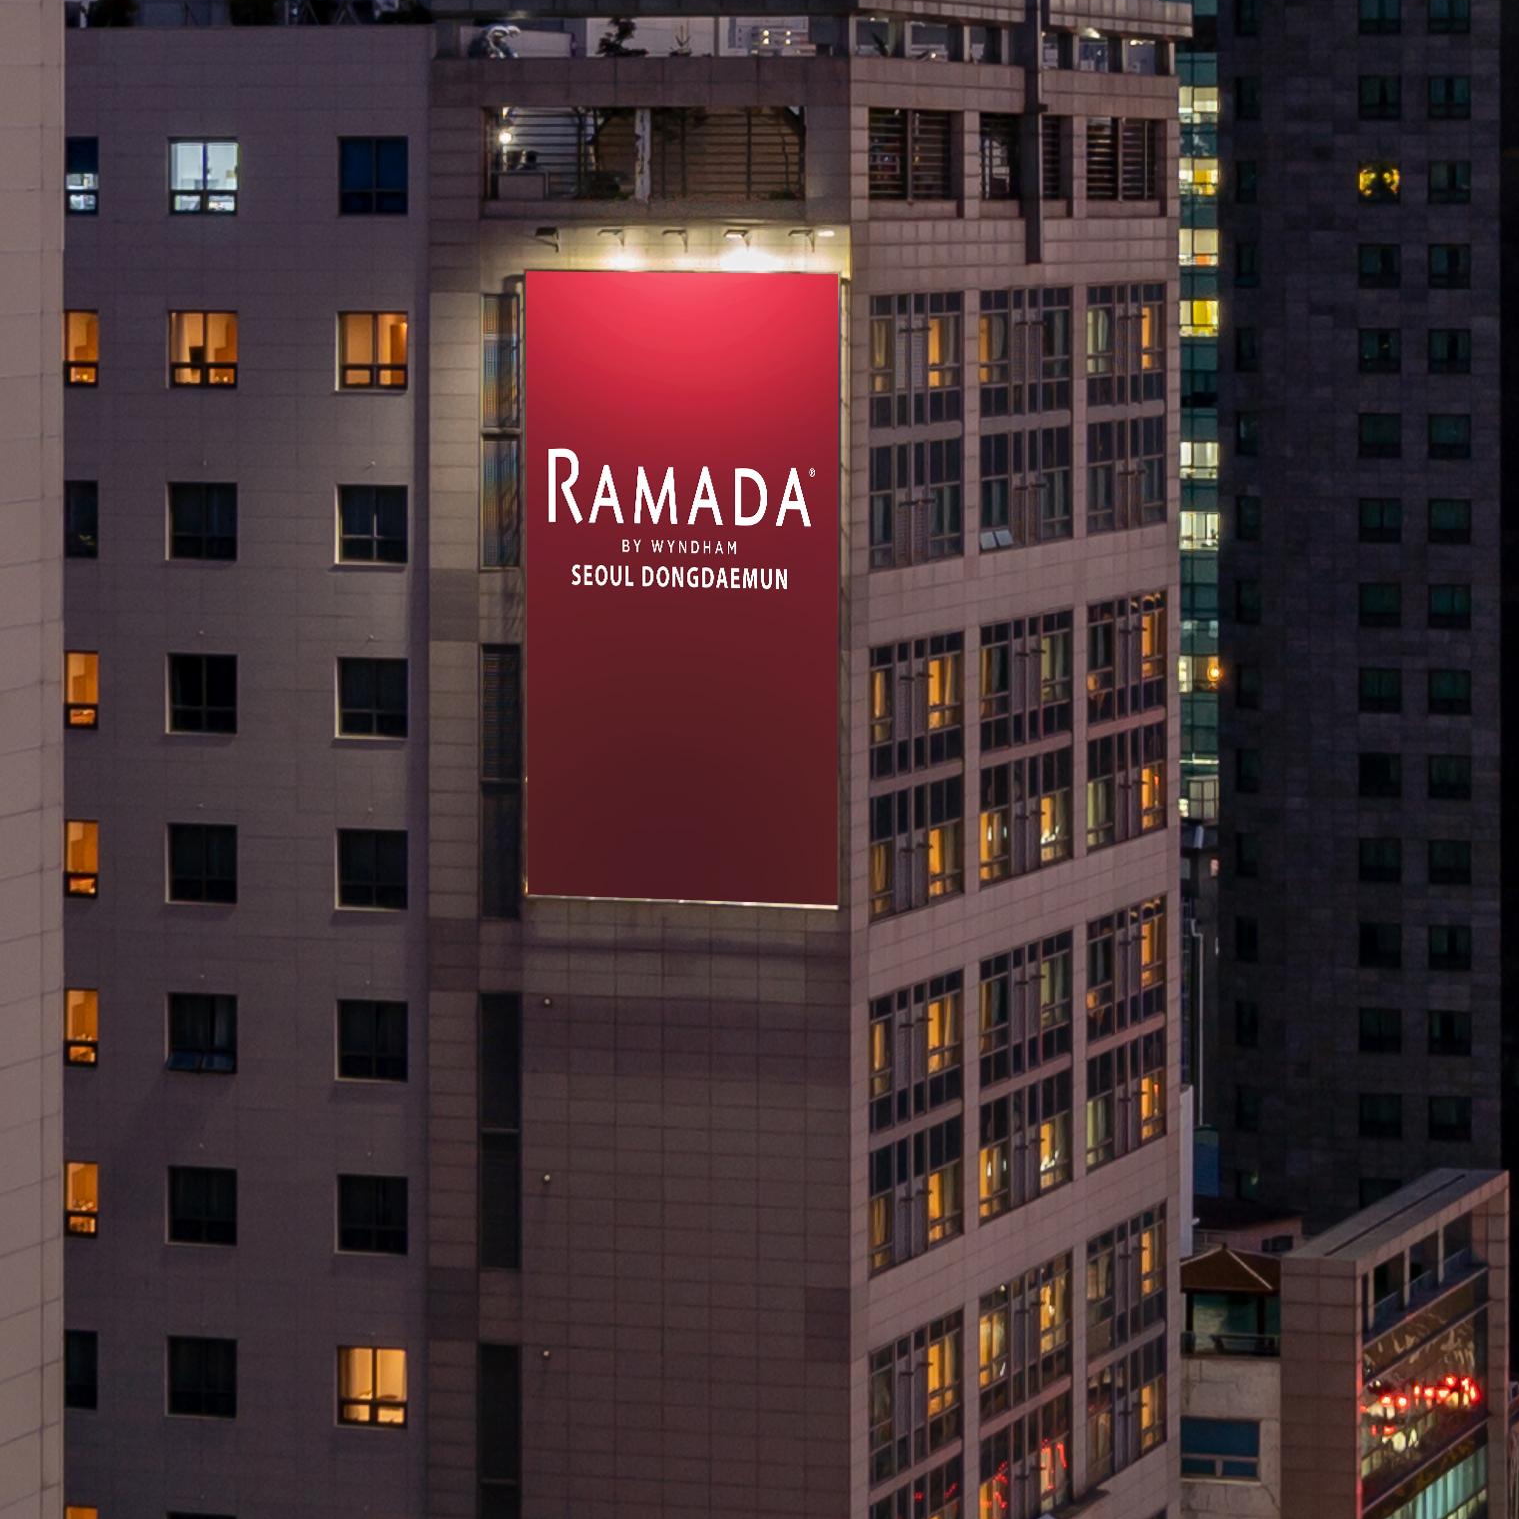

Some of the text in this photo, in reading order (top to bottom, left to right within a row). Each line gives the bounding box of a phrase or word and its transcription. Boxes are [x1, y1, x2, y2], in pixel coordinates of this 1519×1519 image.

[547, 447, 812, 528] RAMADA
[621, 538, 738, 556] BY WYNDHAM
[570, 564, 789, 591] SEOUL DONGDAEMUN
